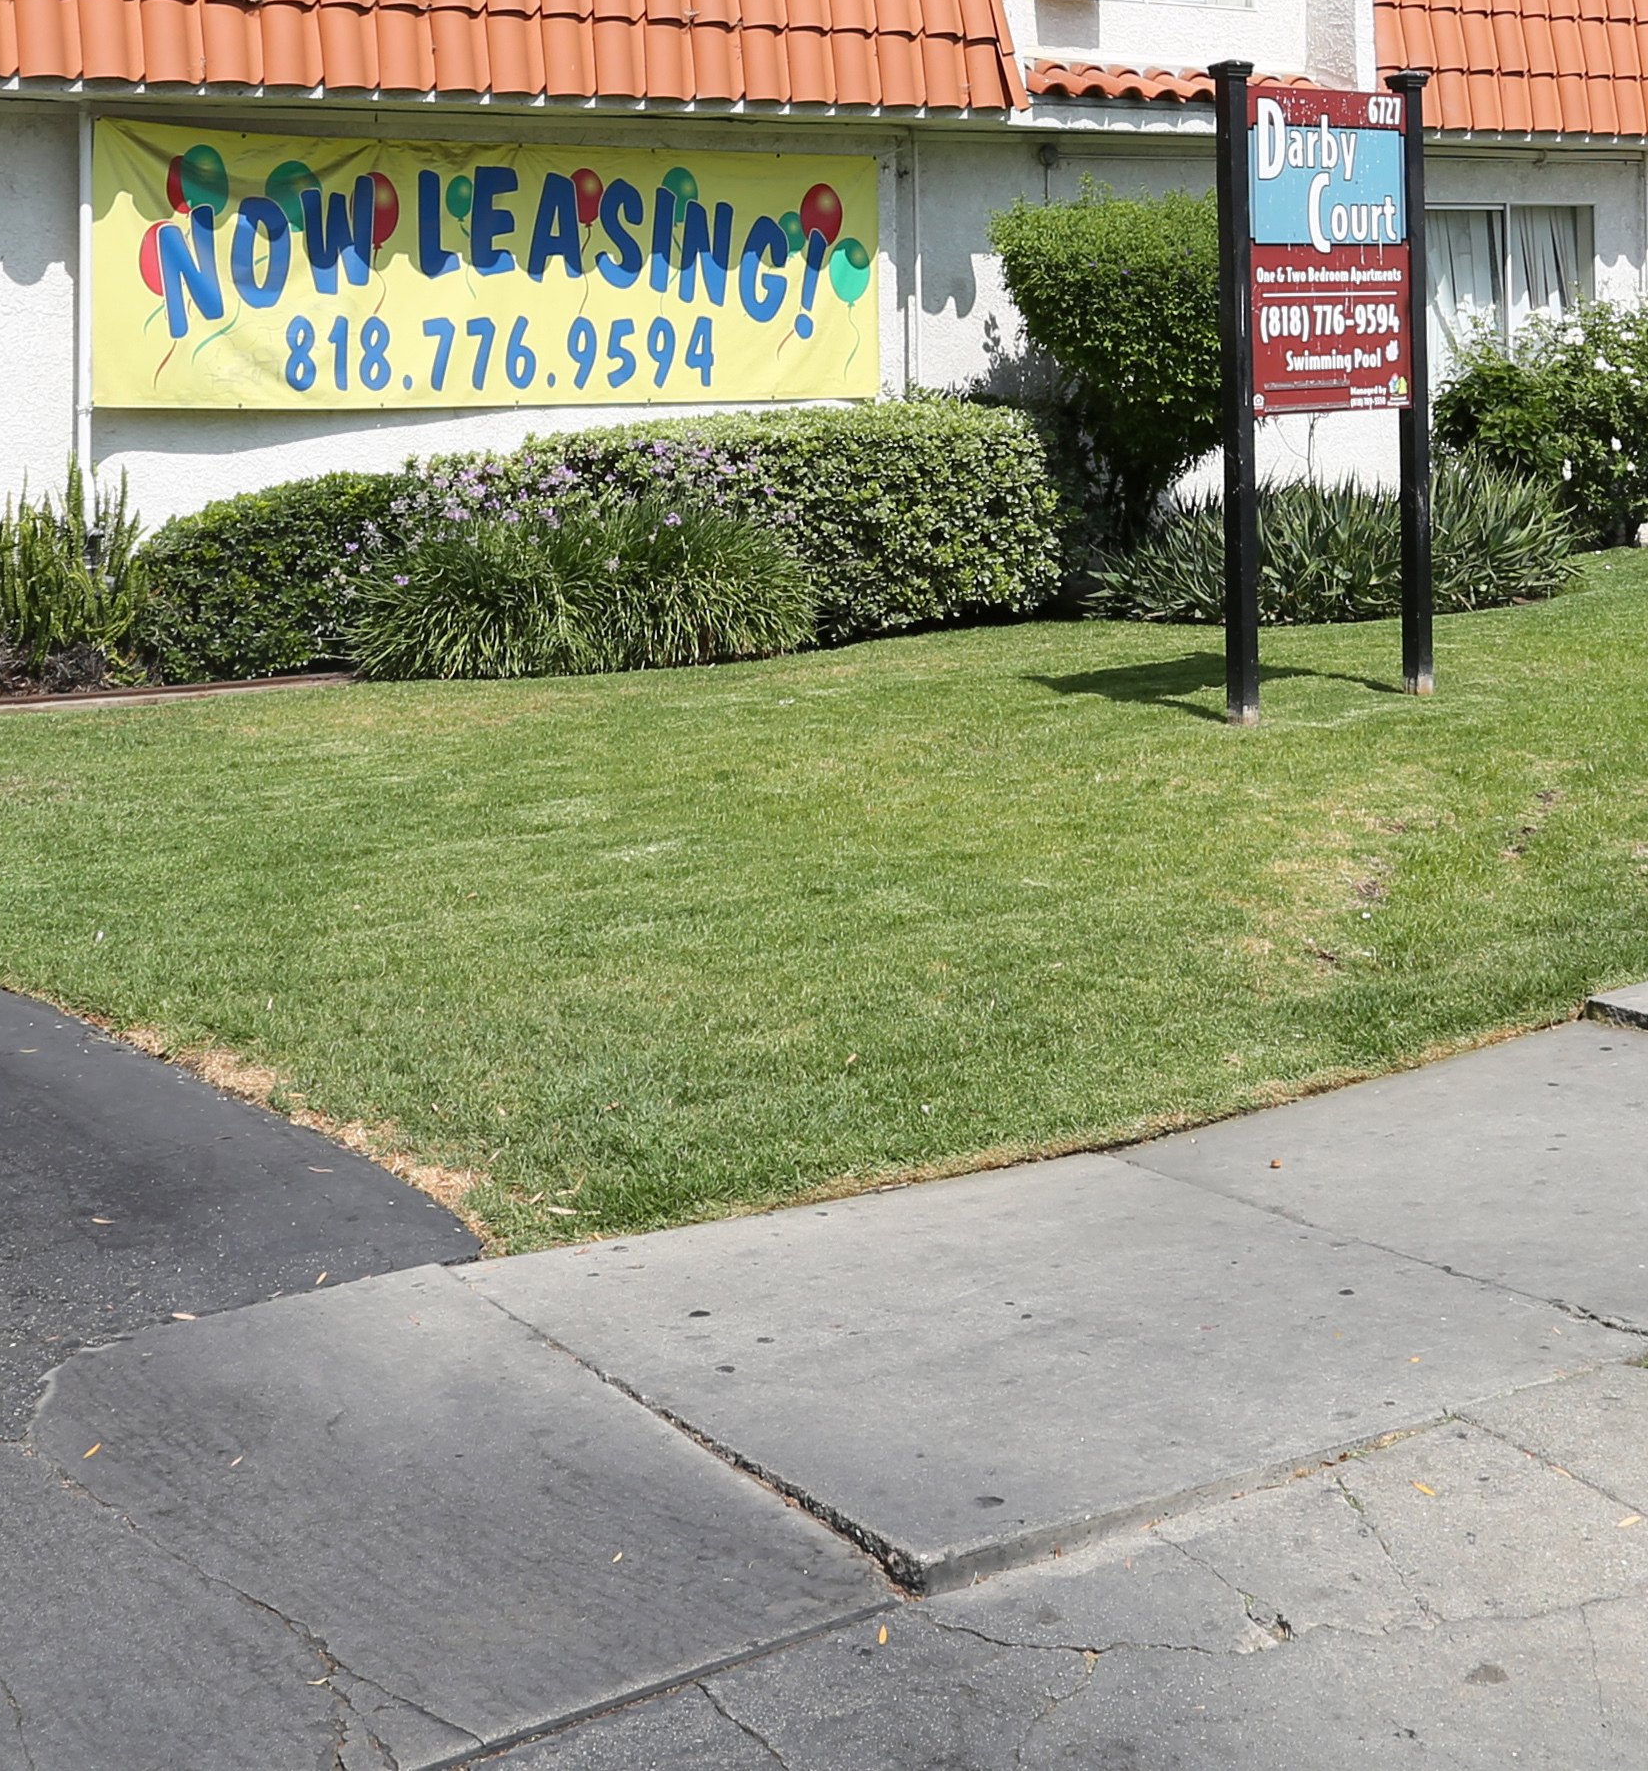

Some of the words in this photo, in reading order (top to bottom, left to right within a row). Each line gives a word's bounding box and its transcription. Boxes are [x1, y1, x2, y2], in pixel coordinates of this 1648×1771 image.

[1257, 97, 1357, 181] Darby
[1367, 95, 1401, 125] 6727
[1308, 171, 1398, 254] Court
[156, 174, 375, 339] NOW
[418, 165, 828, 339] LEASING!
[1256, 266, 1276, 283] One
[1276, 266, 1285, 283] &
[1286, 266, 1307, 283] Two
[1308, 266, 1349, 283] Bedroom
[1350, 266, 1402, 285] Apartments
[284, 315, 714, 391] 818.776.9594
[1260, 305, 1310, 344] (818)
[1313, 304, 1400, 336] 776-9594
[1285, 348, 1352, 374] Swimming
[1354, 347, 1382, 369] Pool
